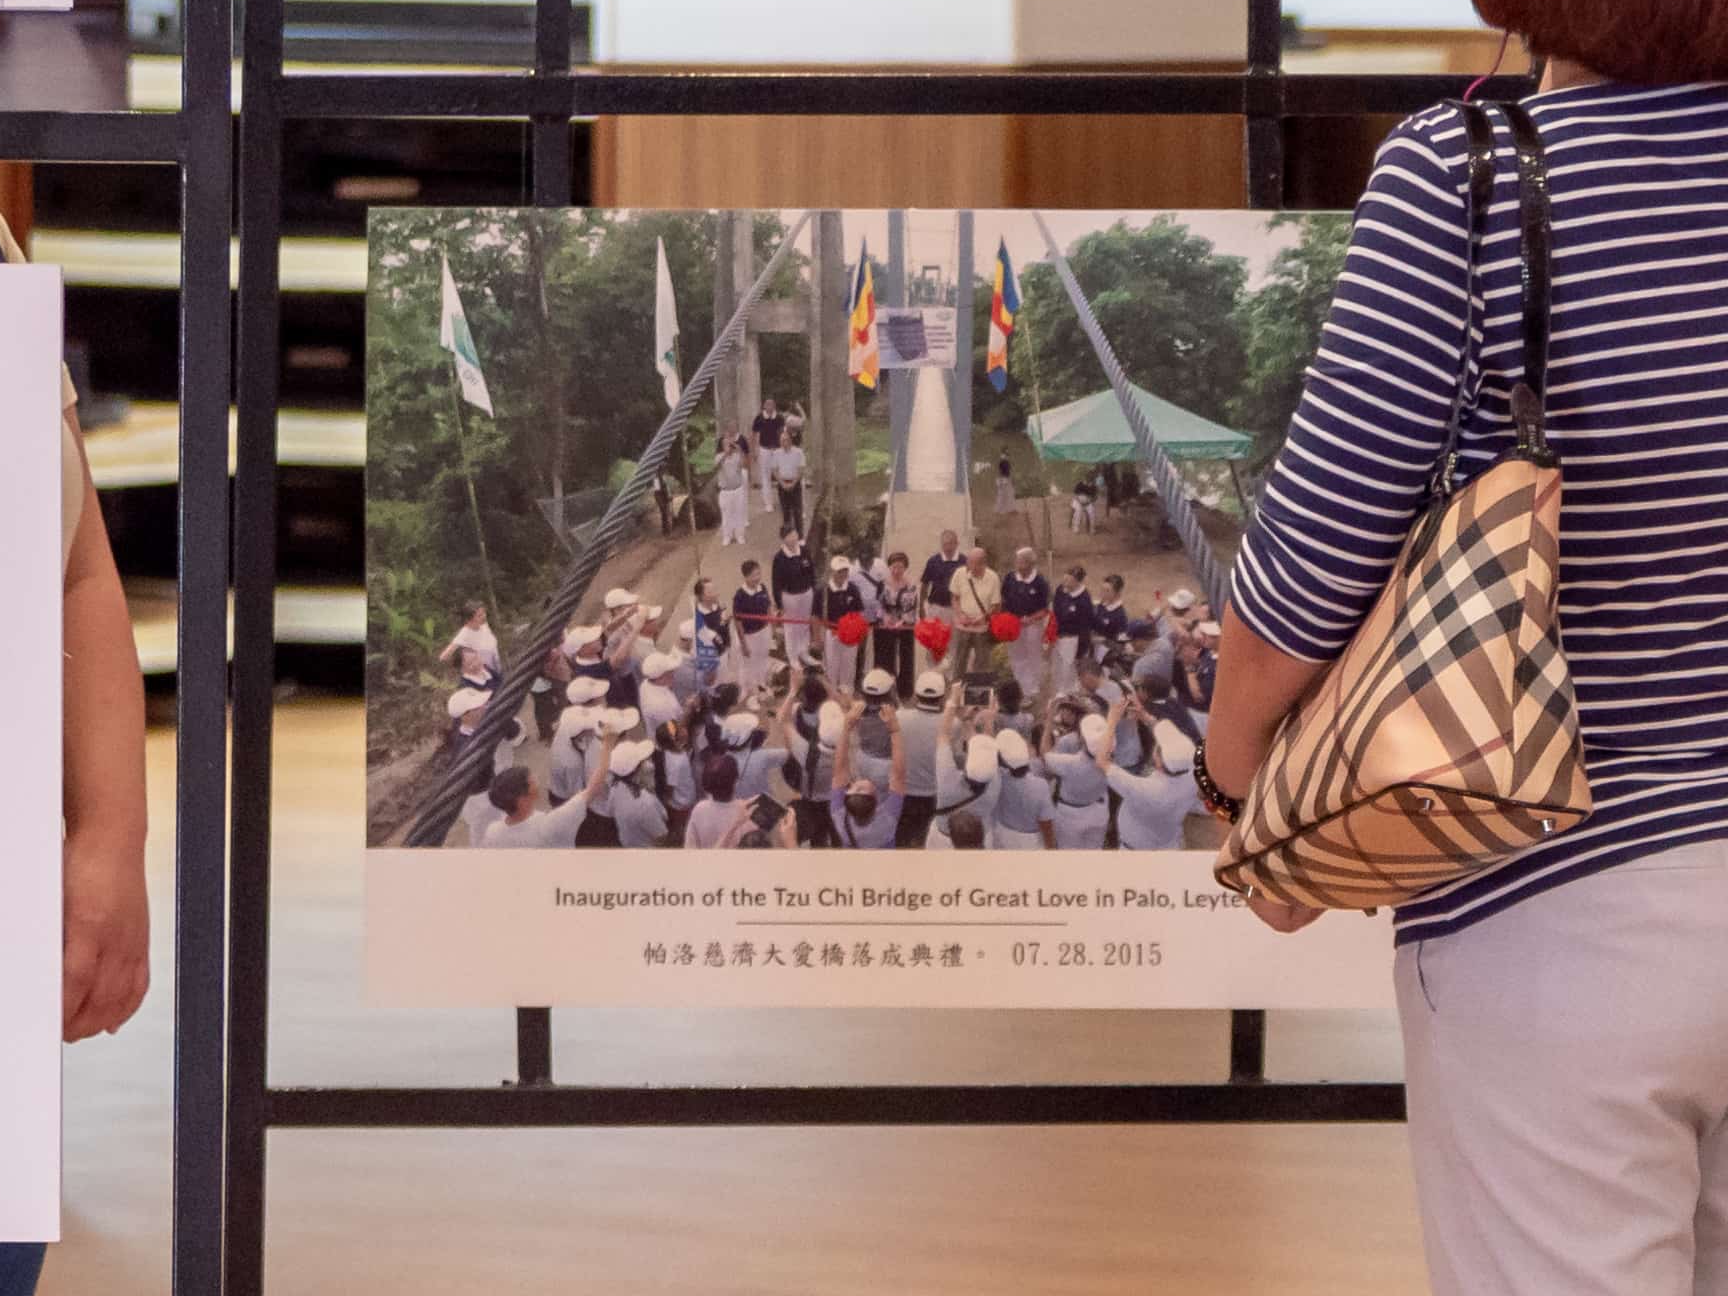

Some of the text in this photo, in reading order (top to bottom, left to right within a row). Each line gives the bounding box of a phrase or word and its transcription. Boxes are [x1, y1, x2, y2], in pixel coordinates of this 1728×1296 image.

[555, 887, 1248, 912] Inauguration of the Tzu Chi Bridge of Great Love in Palo, Leyte.
[1011, 941, 1163, 967] 07.28.2015
